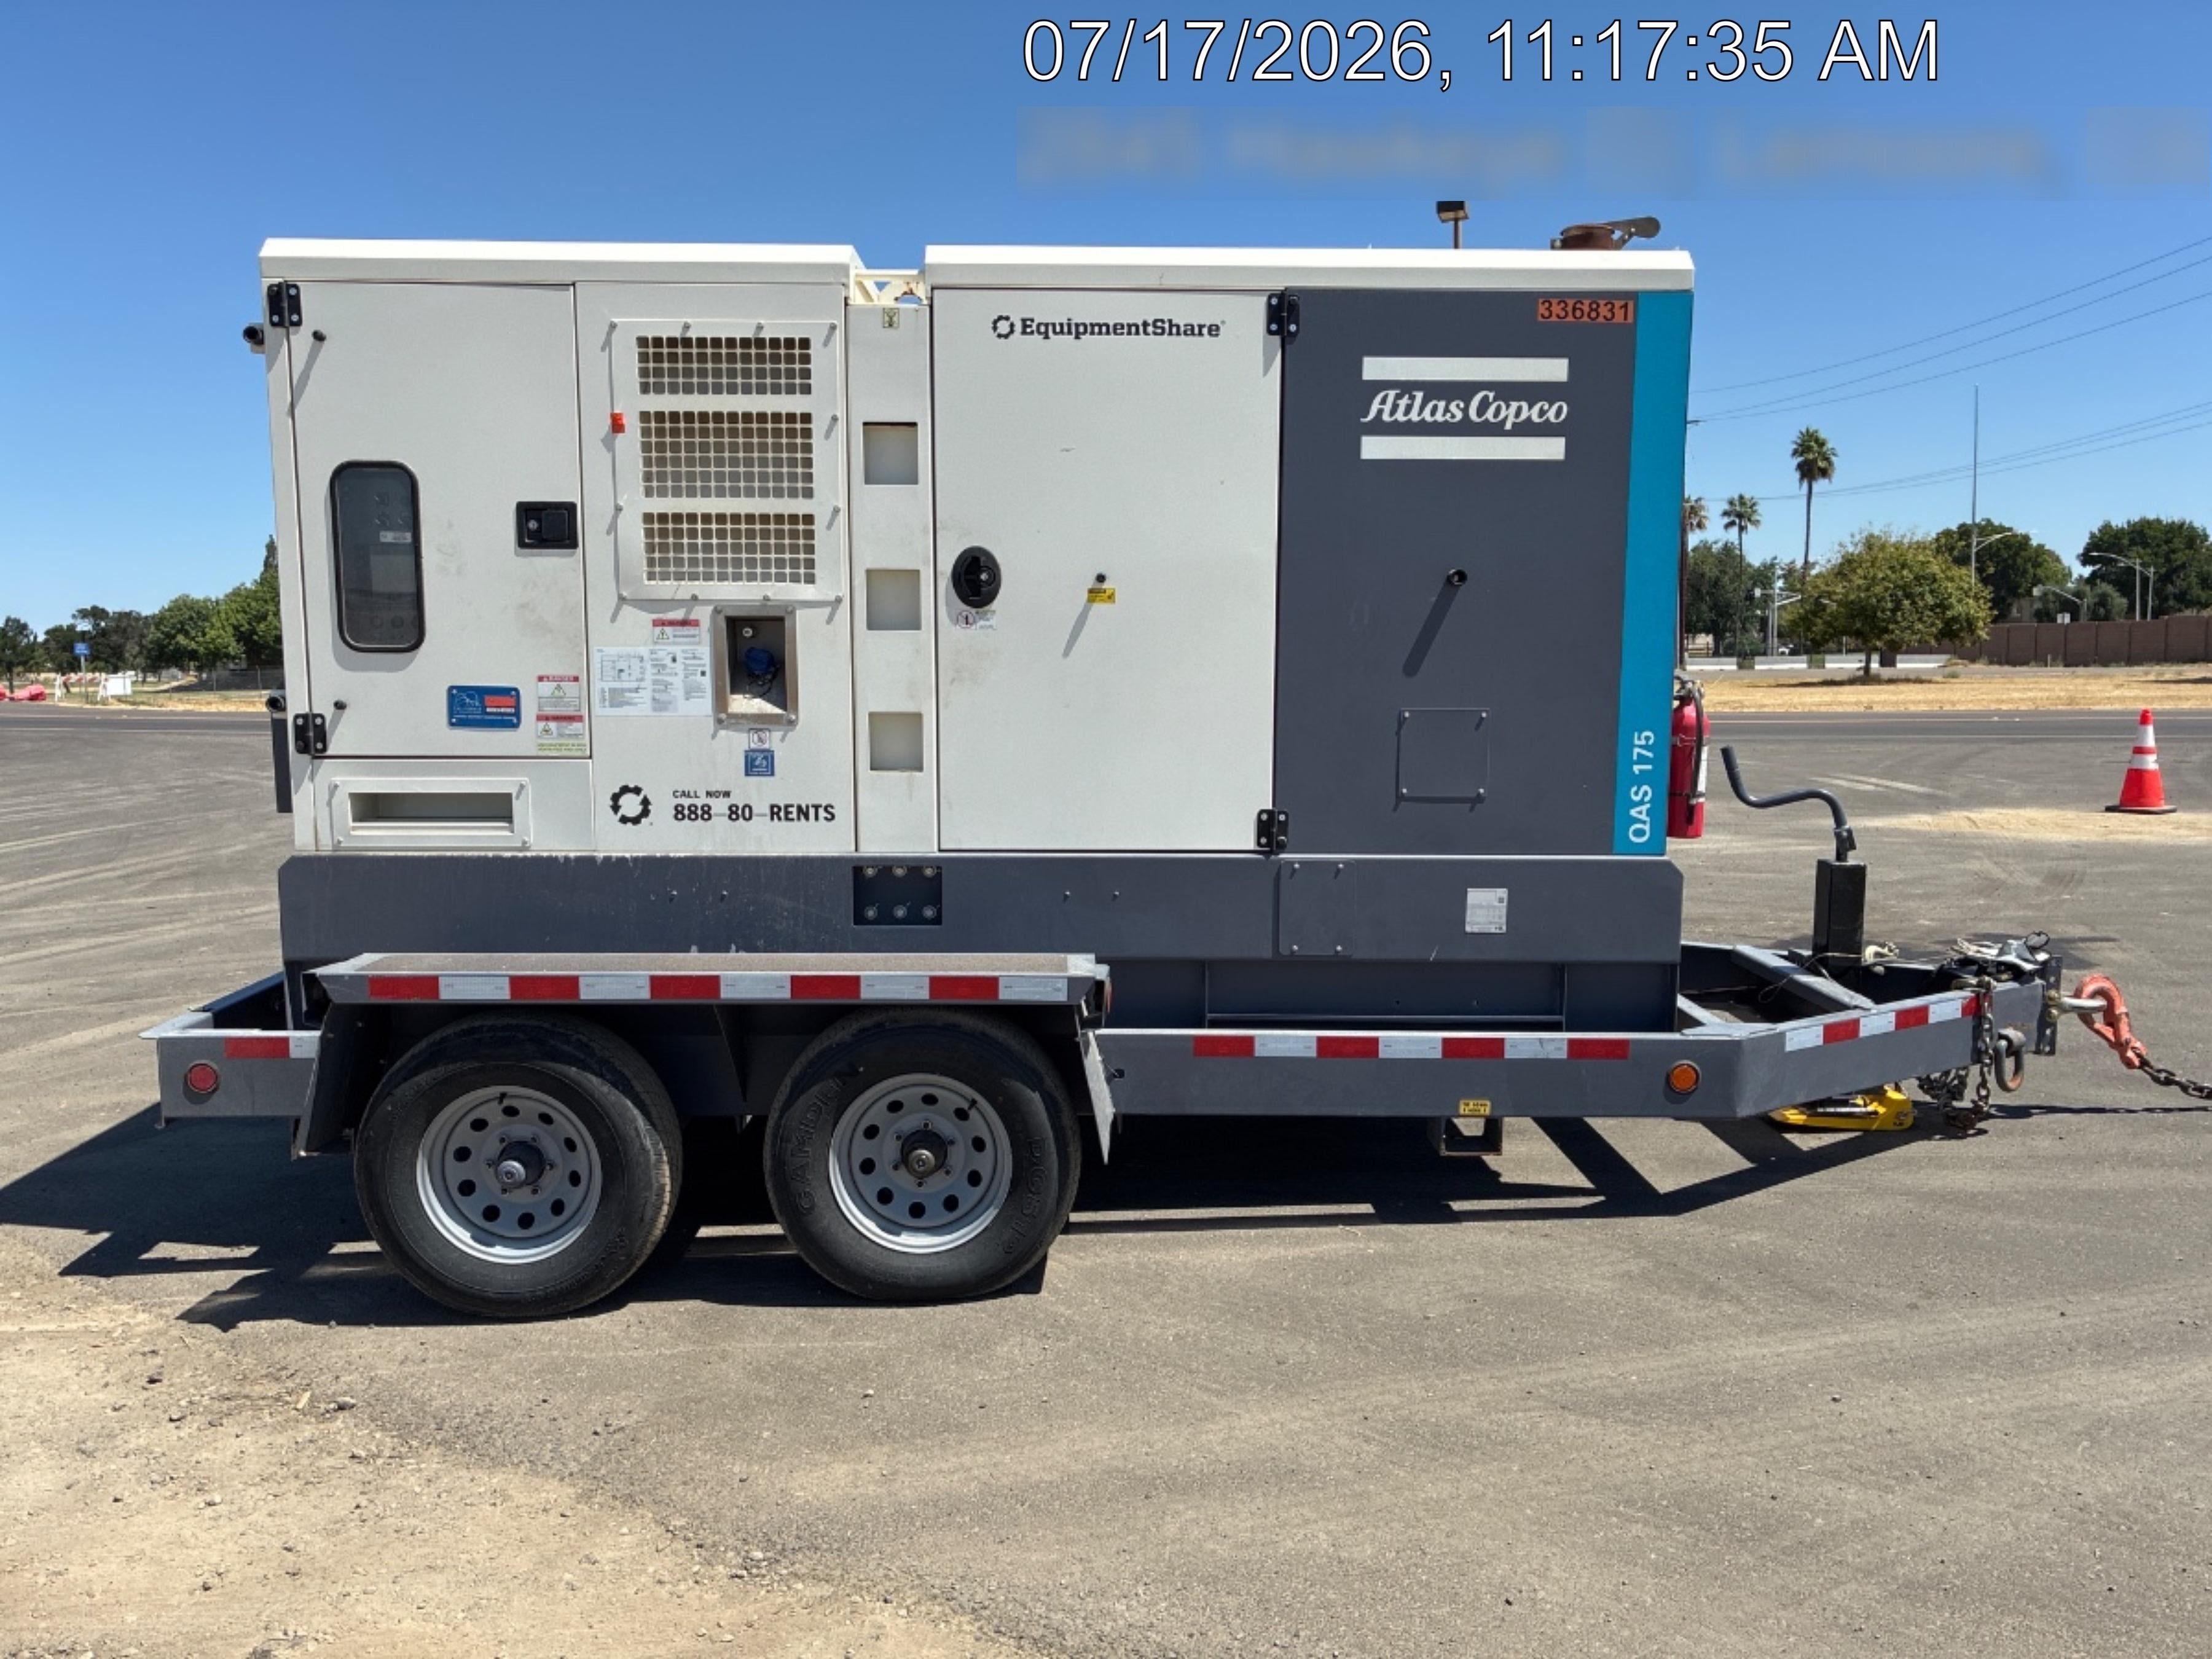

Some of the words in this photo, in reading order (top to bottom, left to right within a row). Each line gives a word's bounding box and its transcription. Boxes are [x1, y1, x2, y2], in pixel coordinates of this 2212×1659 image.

[1540, 300, 1631, 321] 336831
[1019, 317, 1221, 339] EquipmentShare
[1360, 390, 1465, 424] Atlas
[1469, 390, 1569, 430] Copco
[1633, 731, 1655, 774] 175
[672, 790, 700, 799] CALL
[705, 790, 732, 799] NOW
[1628, 785, 1653, 844] QAS
